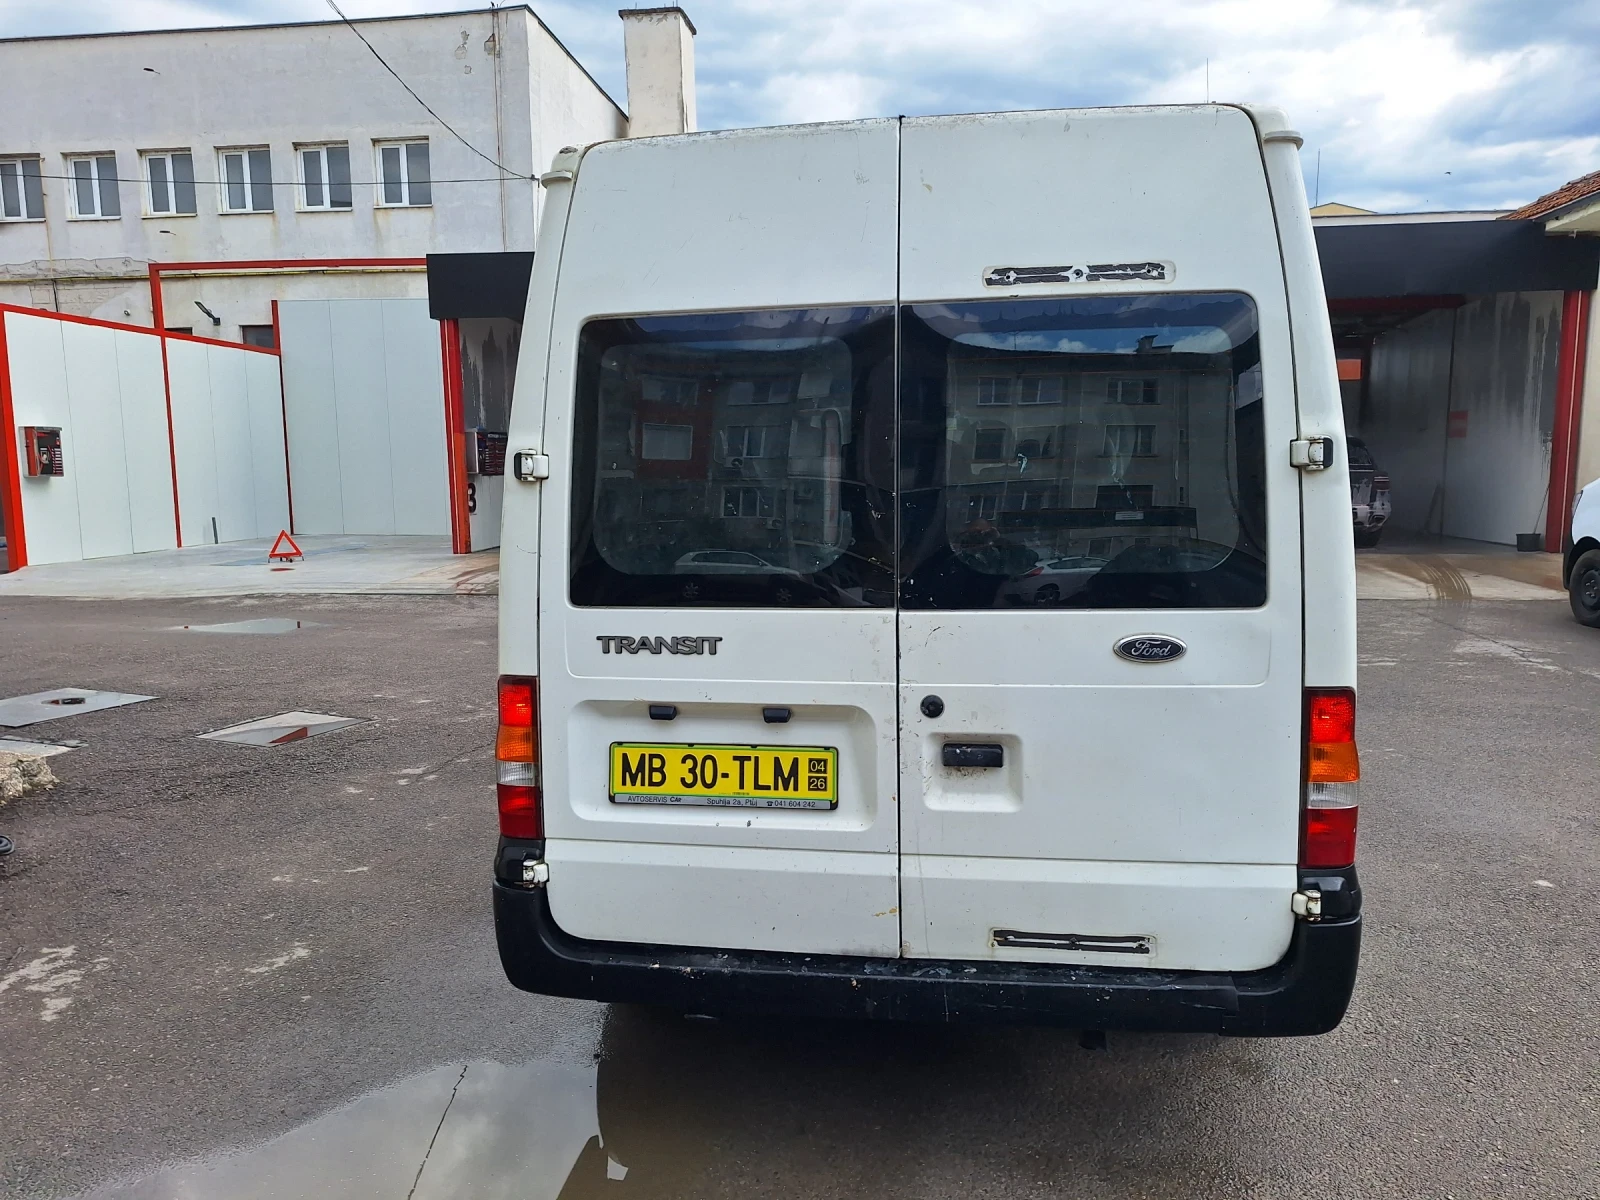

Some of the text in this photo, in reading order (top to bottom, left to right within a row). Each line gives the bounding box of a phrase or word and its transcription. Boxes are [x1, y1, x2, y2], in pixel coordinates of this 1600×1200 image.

[596, 636, 723, 655] TRANSIT
[1131, 640, 1172, 656] Ford
[810, 760, 825, 772] 04
[621, 753, 799, 792] MB 30-TLM
[809, 778, 826, 790] 26
[627, 795, 668, 803] AVTOSERVIS
[706, 797, 731, 806] Spuhlja
[732, 798, 744, 806] 2a,
[774, 799, 816, 808] 041 604 242
